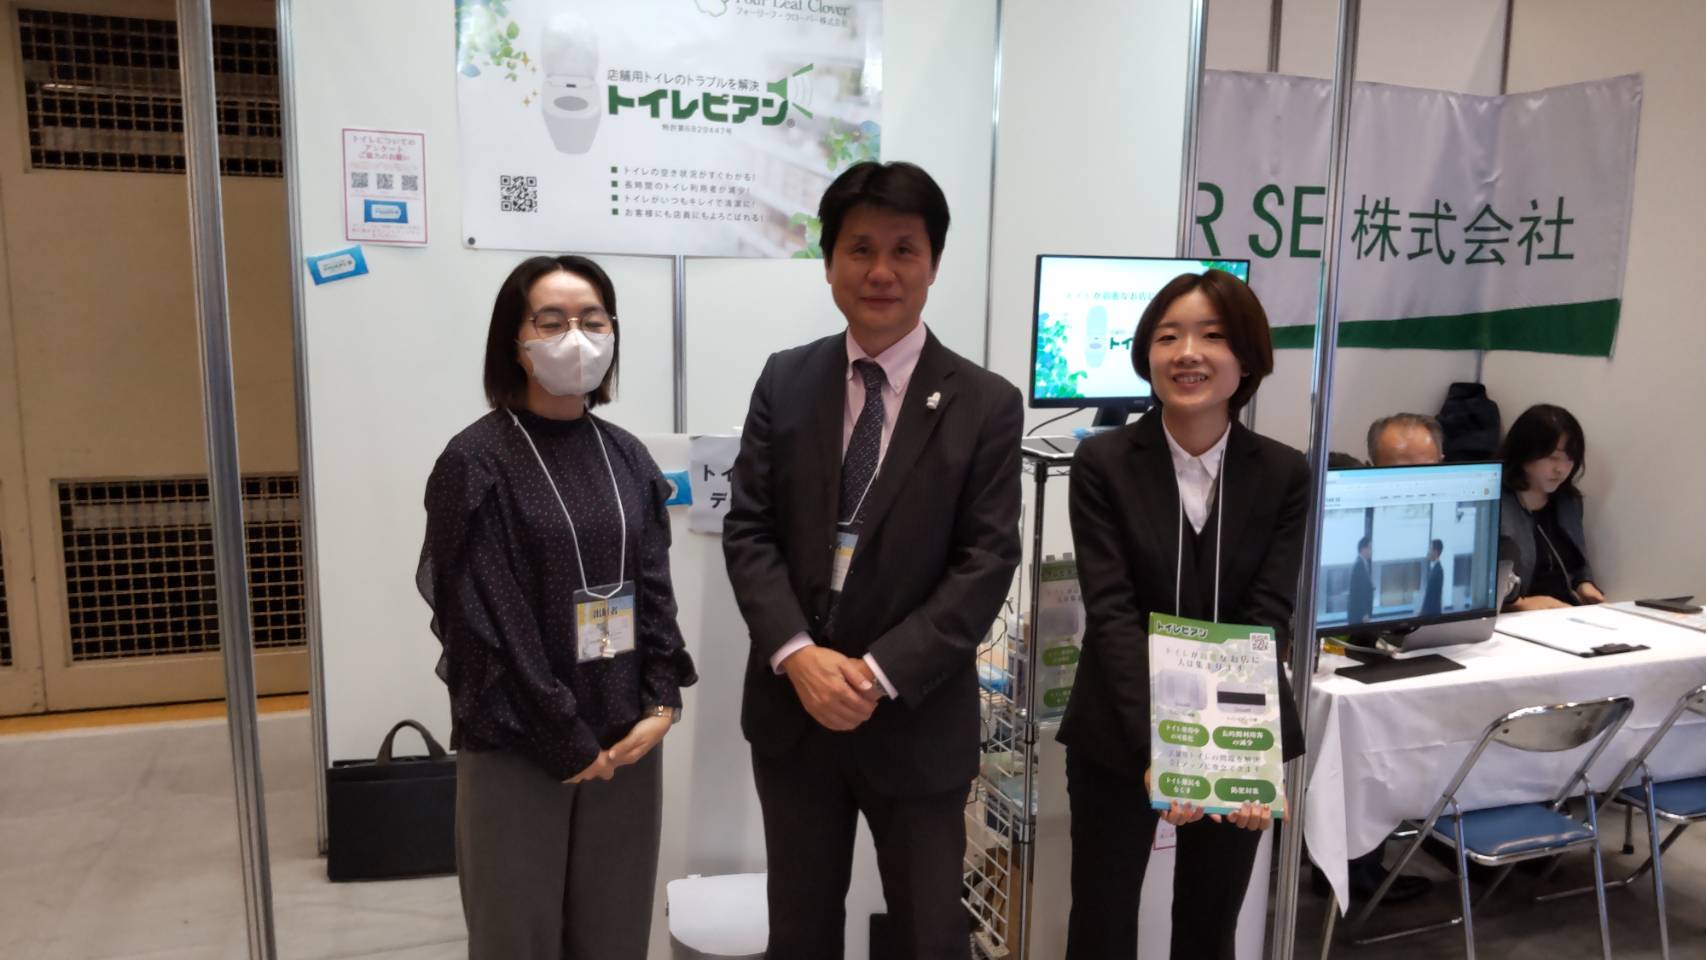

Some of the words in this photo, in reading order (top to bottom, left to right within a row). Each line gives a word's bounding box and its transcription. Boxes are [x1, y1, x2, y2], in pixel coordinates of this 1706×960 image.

[807, 0, 850, 16] Clover
[607, 69, 760, 92] 店舗用トイレのトラブルを解決
[608, 85, 789, 126] トイレビアン
[1351, 194, 1575, 266] 株式会社
